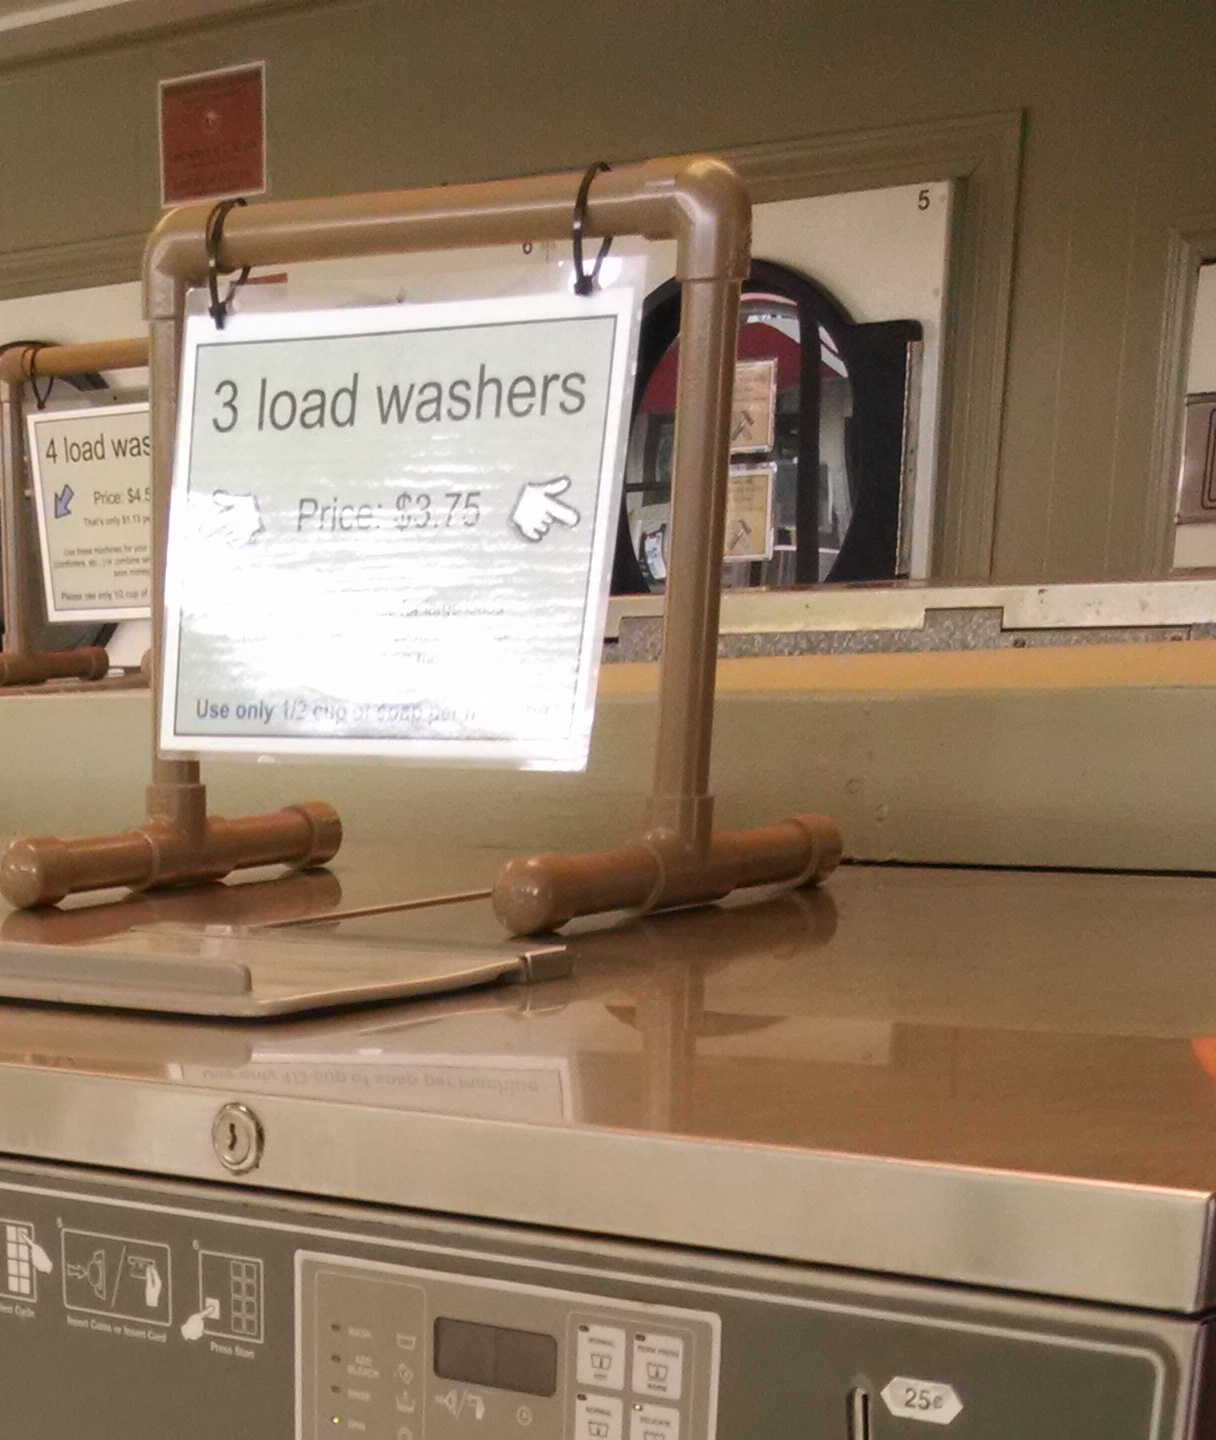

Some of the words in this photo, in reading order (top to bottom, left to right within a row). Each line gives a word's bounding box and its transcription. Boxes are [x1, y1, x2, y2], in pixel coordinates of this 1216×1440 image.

[917, 189, 930, 211] 5
[211, 379, 239, 433] 3
[257, 373, 359, 432] load
[376, 364, 587, 425] washers
[45, 437, 58, 464] 4
[63, 433, 106, 463] load
[296, 496, 383, 532] Price:
[394, 491, 482, 531] $3.75
[195, 698, 231, 719] Use
[235, 699, 275, 725] only
[283, 698, 308, 720] 1/2
